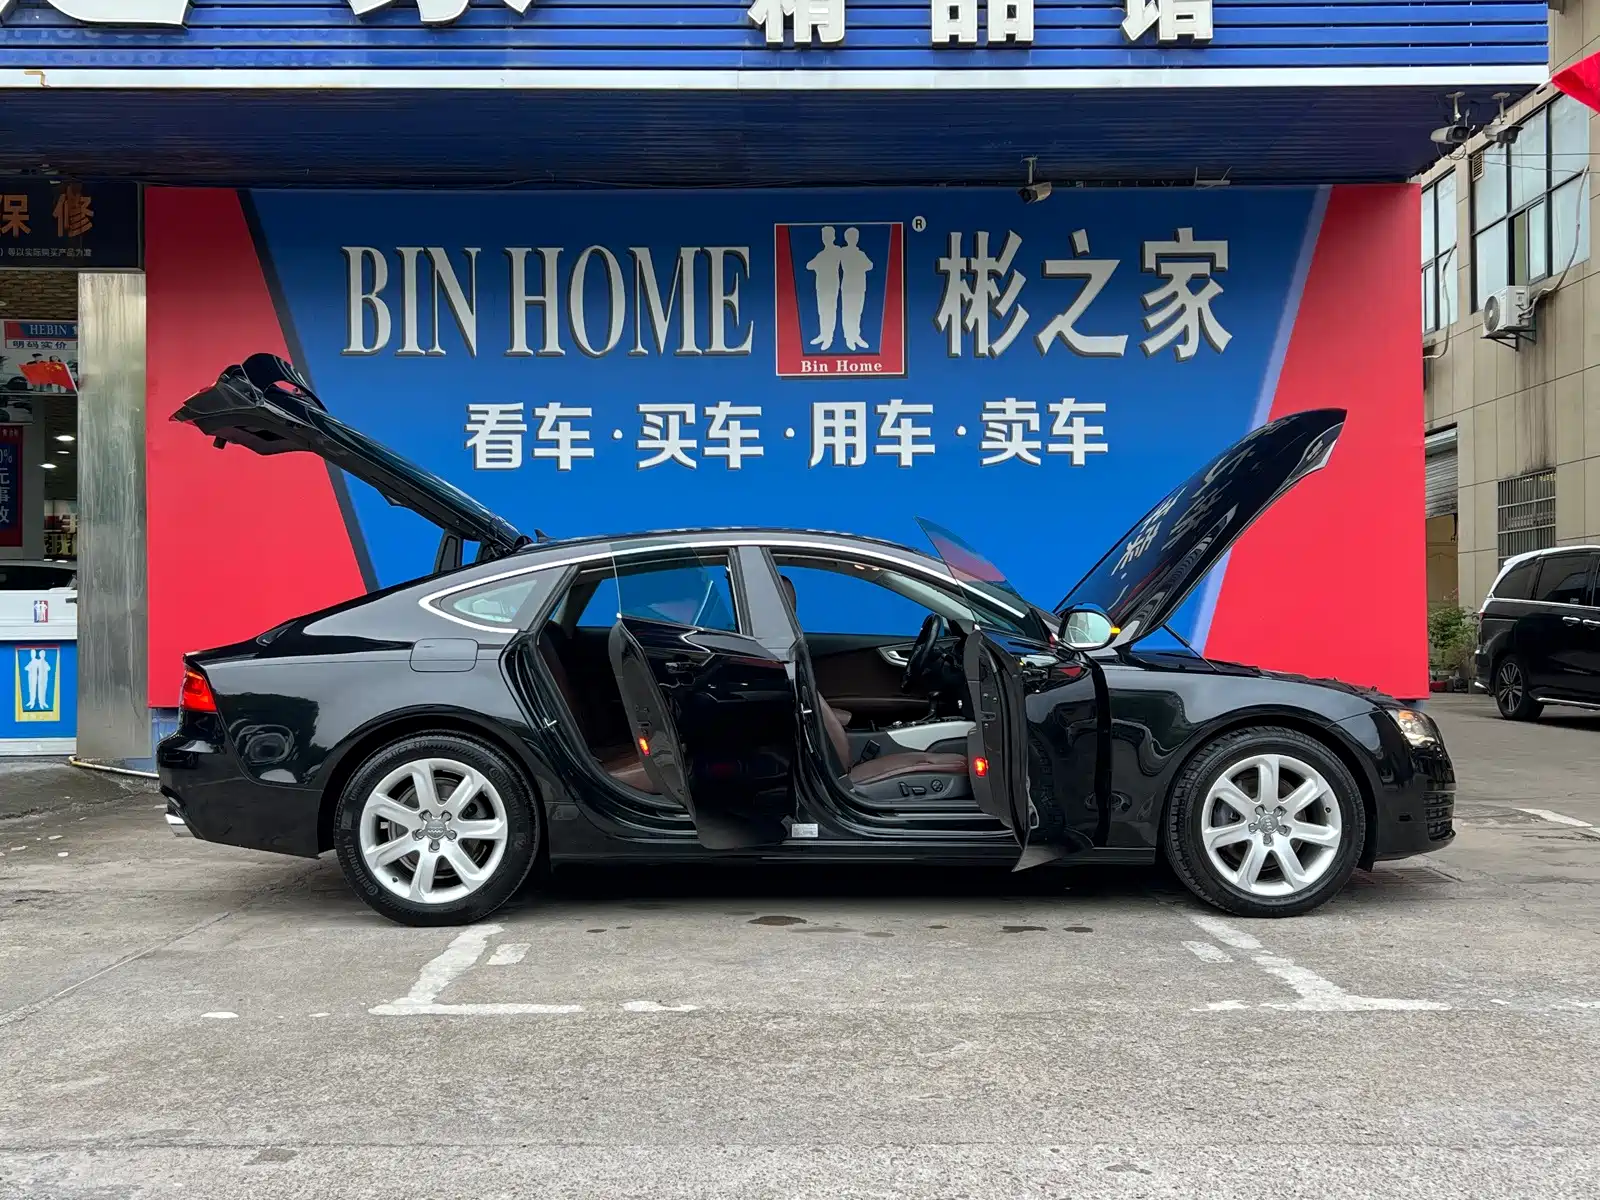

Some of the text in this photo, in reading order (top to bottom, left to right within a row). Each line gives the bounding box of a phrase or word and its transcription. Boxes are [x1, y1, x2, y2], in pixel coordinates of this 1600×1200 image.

[341, 245, 754, 358] BIN HOME
[935, 227, 1233, 362] 彬之家
[30, 324, 68, 335] HEBIN
[800, 360, 882, 373] Bin Home
[344, 843, 379, 896] Continental
